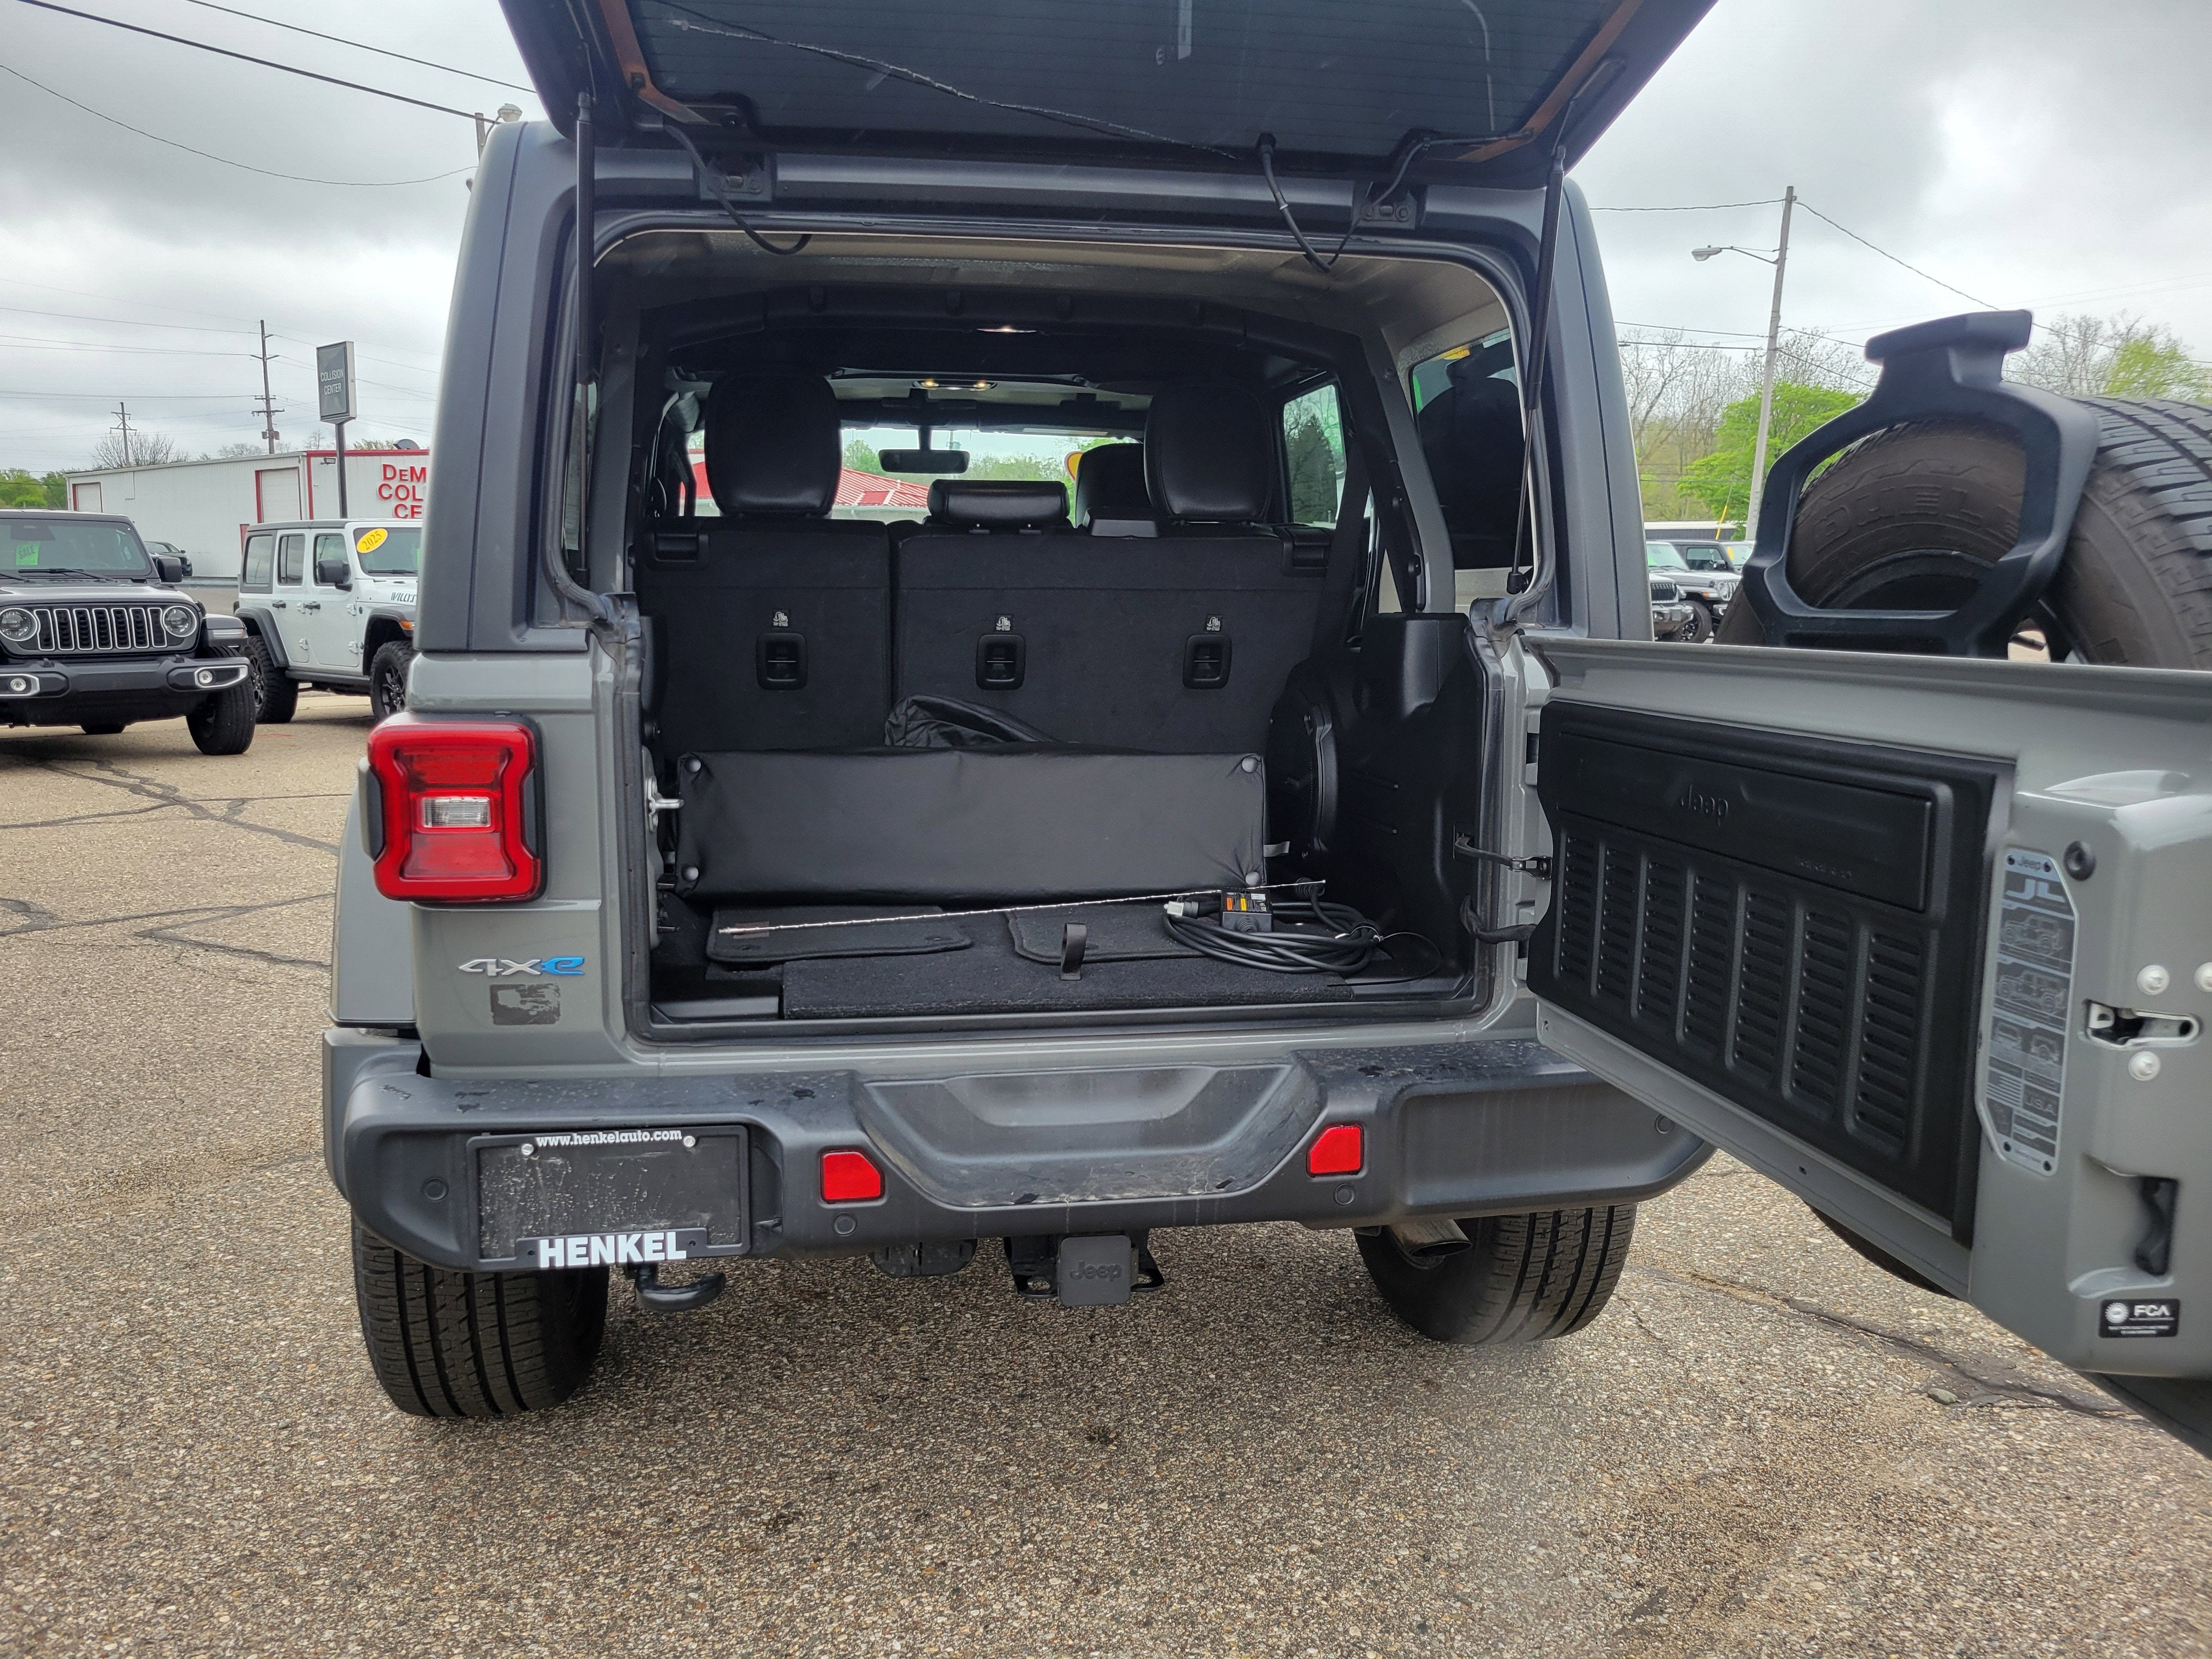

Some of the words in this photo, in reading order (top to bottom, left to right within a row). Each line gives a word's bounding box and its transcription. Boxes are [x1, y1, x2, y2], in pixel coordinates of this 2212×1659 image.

[320, 368, 344, 382] COLLISION
[324, 382, 342, 395] CENTER
[362, 530, 382, 550] 2025
[2005, 878, 2066, 904] JL
[535, 1130, 682, 1147] www.henkelauto.com
[539, 1231, 687, 1268] HENKEL
[1070, 1260, 1123, 1283] Jeep
[2134, 1304, 2170, 1317] FCA
